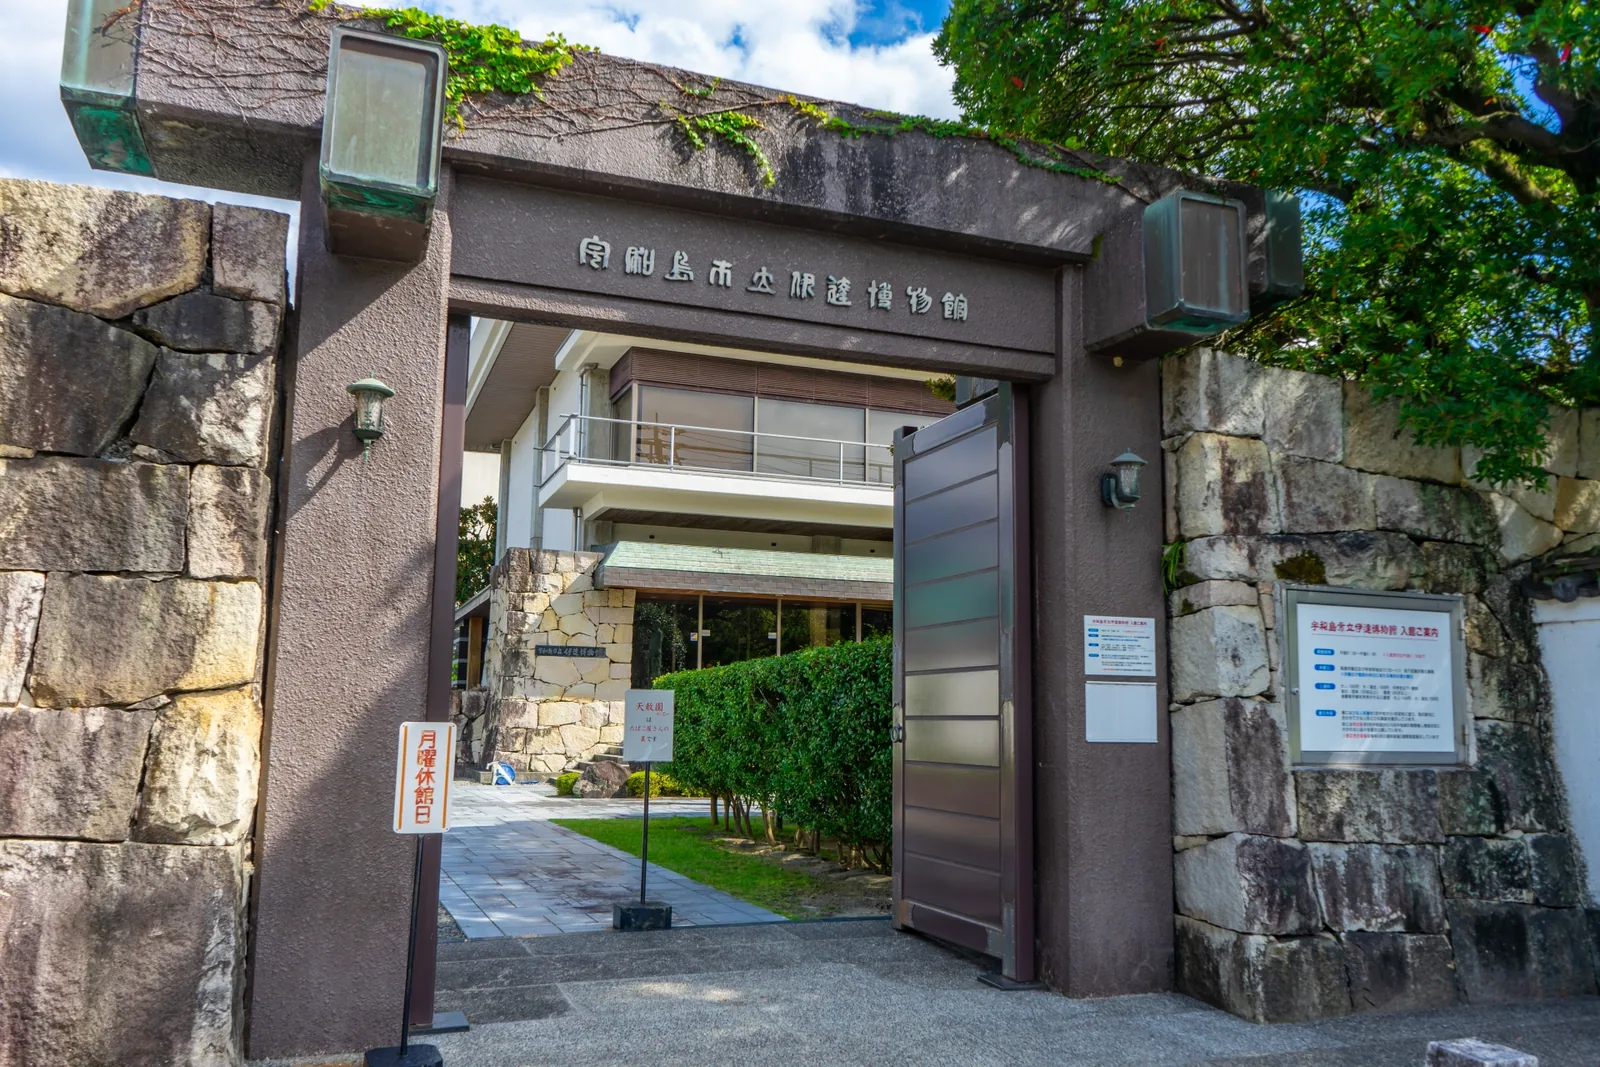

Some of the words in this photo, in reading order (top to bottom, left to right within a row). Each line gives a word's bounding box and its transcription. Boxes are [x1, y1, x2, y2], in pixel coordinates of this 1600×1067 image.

[414, 730, 437, 824] 月曜休館日
